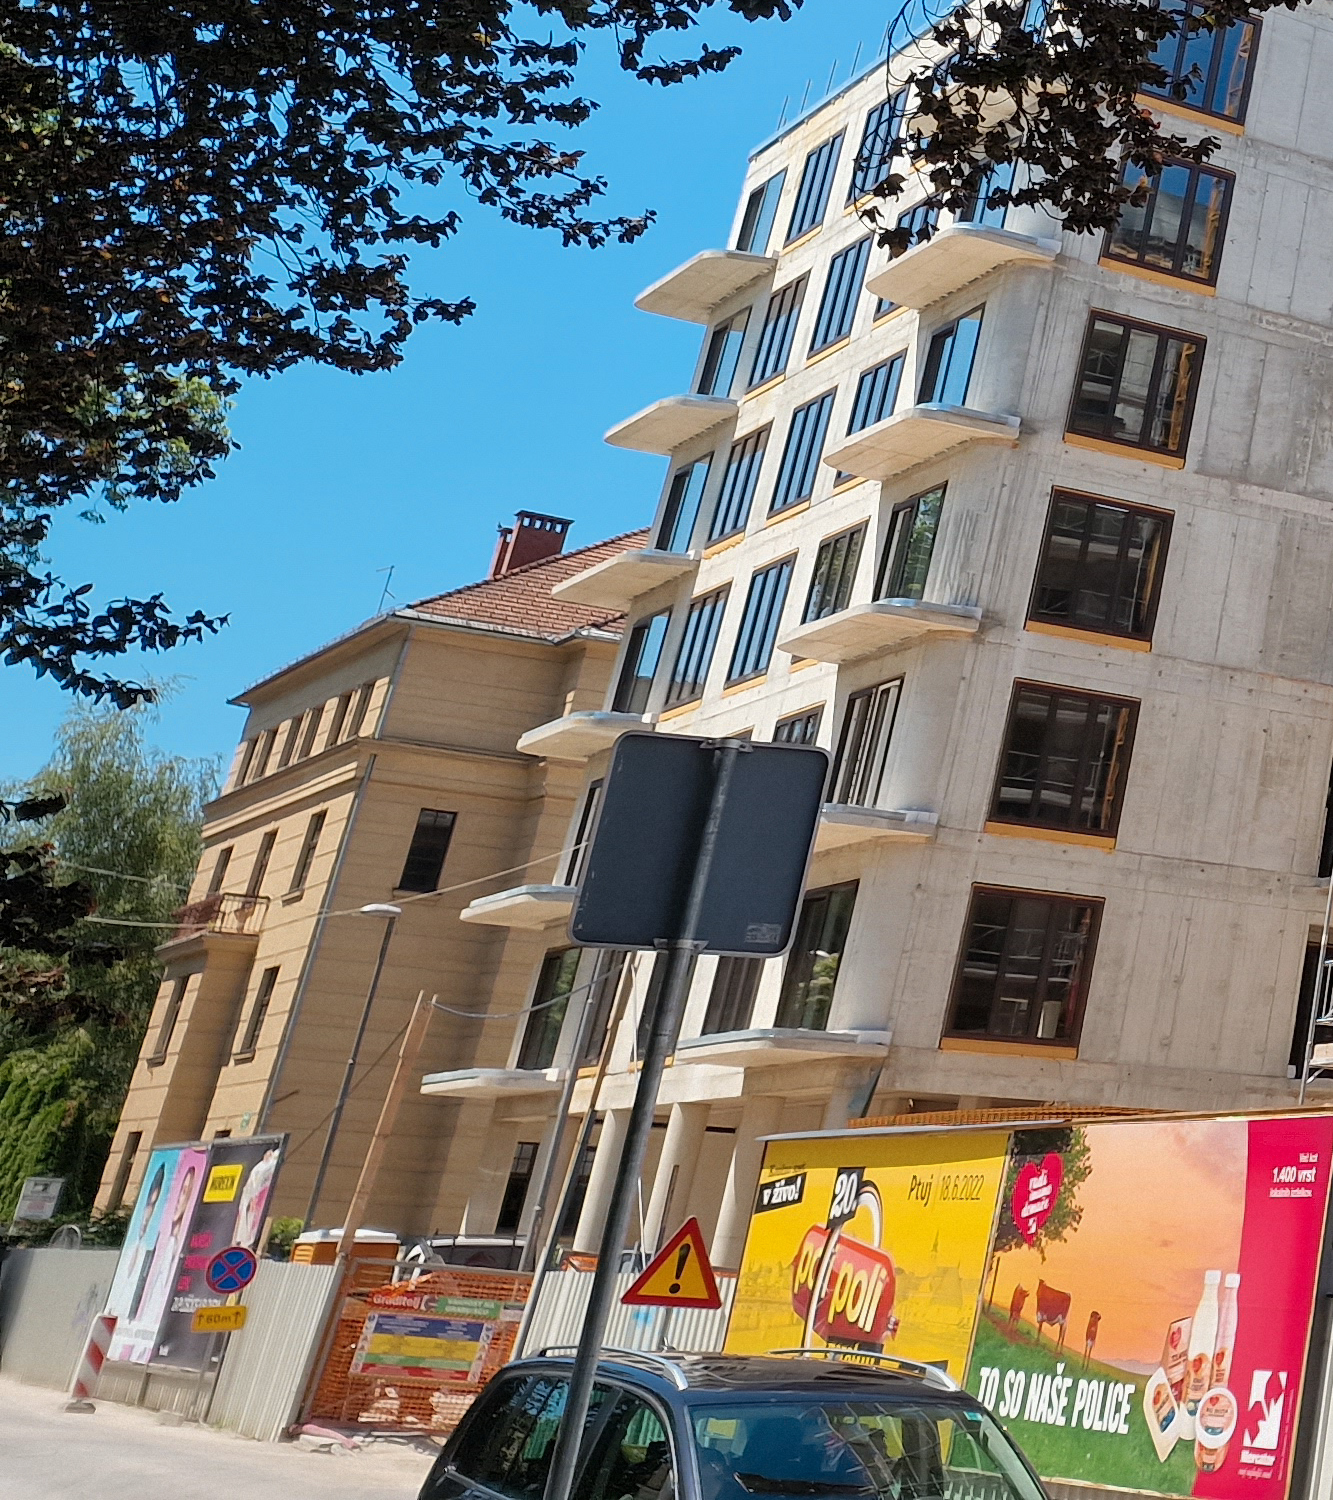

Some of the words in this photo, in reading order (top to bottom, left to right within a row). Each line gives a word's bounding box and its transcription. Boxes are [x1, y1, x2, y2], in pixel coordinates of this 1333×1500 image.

[907, 1174, 934, 1207] Ptuj
[828, 1259, 890, 1334] poli
[977, 1366, 1000, 1413] TO
[998, 1368, 1027, 1420] SO
[1023, 1362, 1074, 1427] NAŠE
[1071, 1377, 1137, 1436] POLICE
